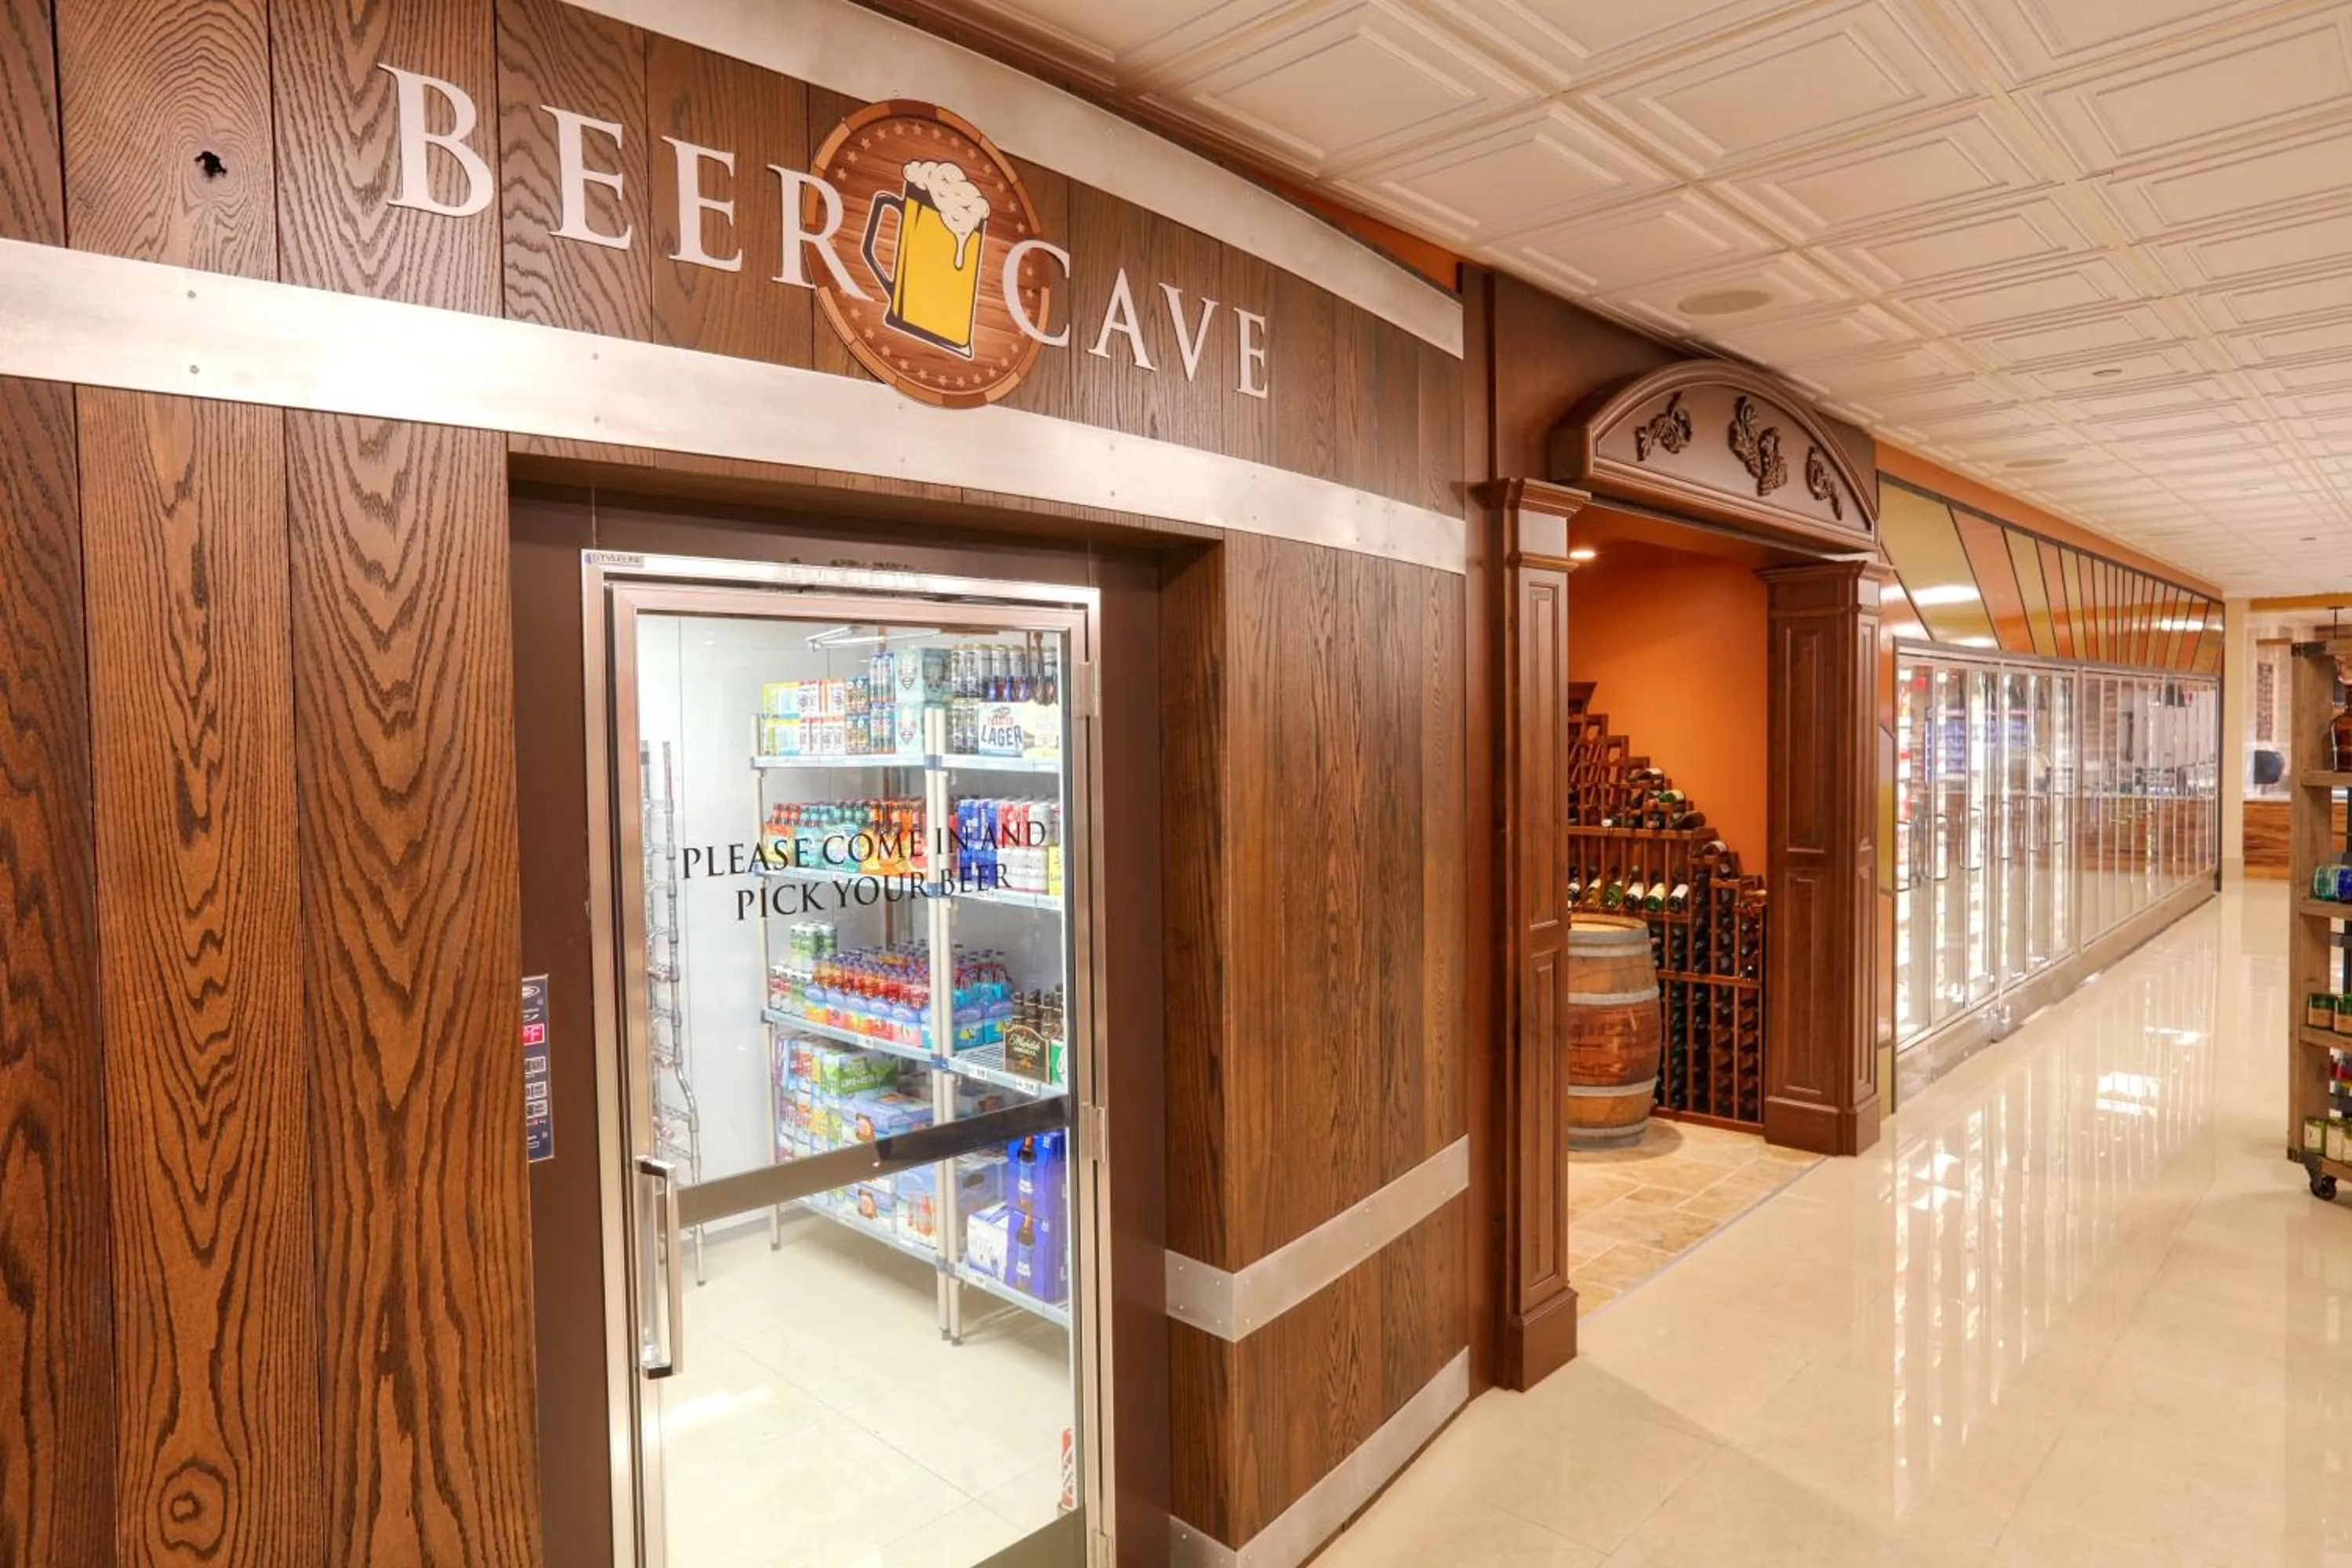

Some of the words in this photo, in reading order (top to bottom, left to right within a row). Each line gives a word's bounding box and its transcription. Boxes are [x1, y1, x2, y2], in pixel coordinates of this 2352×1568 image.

[377, 63, 877, 302] BEER
[1002, 239, 1268, 399] CAVE
[981, 724, 1023, 748] LAGER
[681, 837, 811, 879] PLEASE
[822, 829, 924, 865] COME
[935, 826, 969, 855] IN
[981, 821, 1046, 851] AND
[737, 880, 825, 920] PICK
[833, 871, 931, 909] YOUR
[938, 862, 1013, 896] BEER
